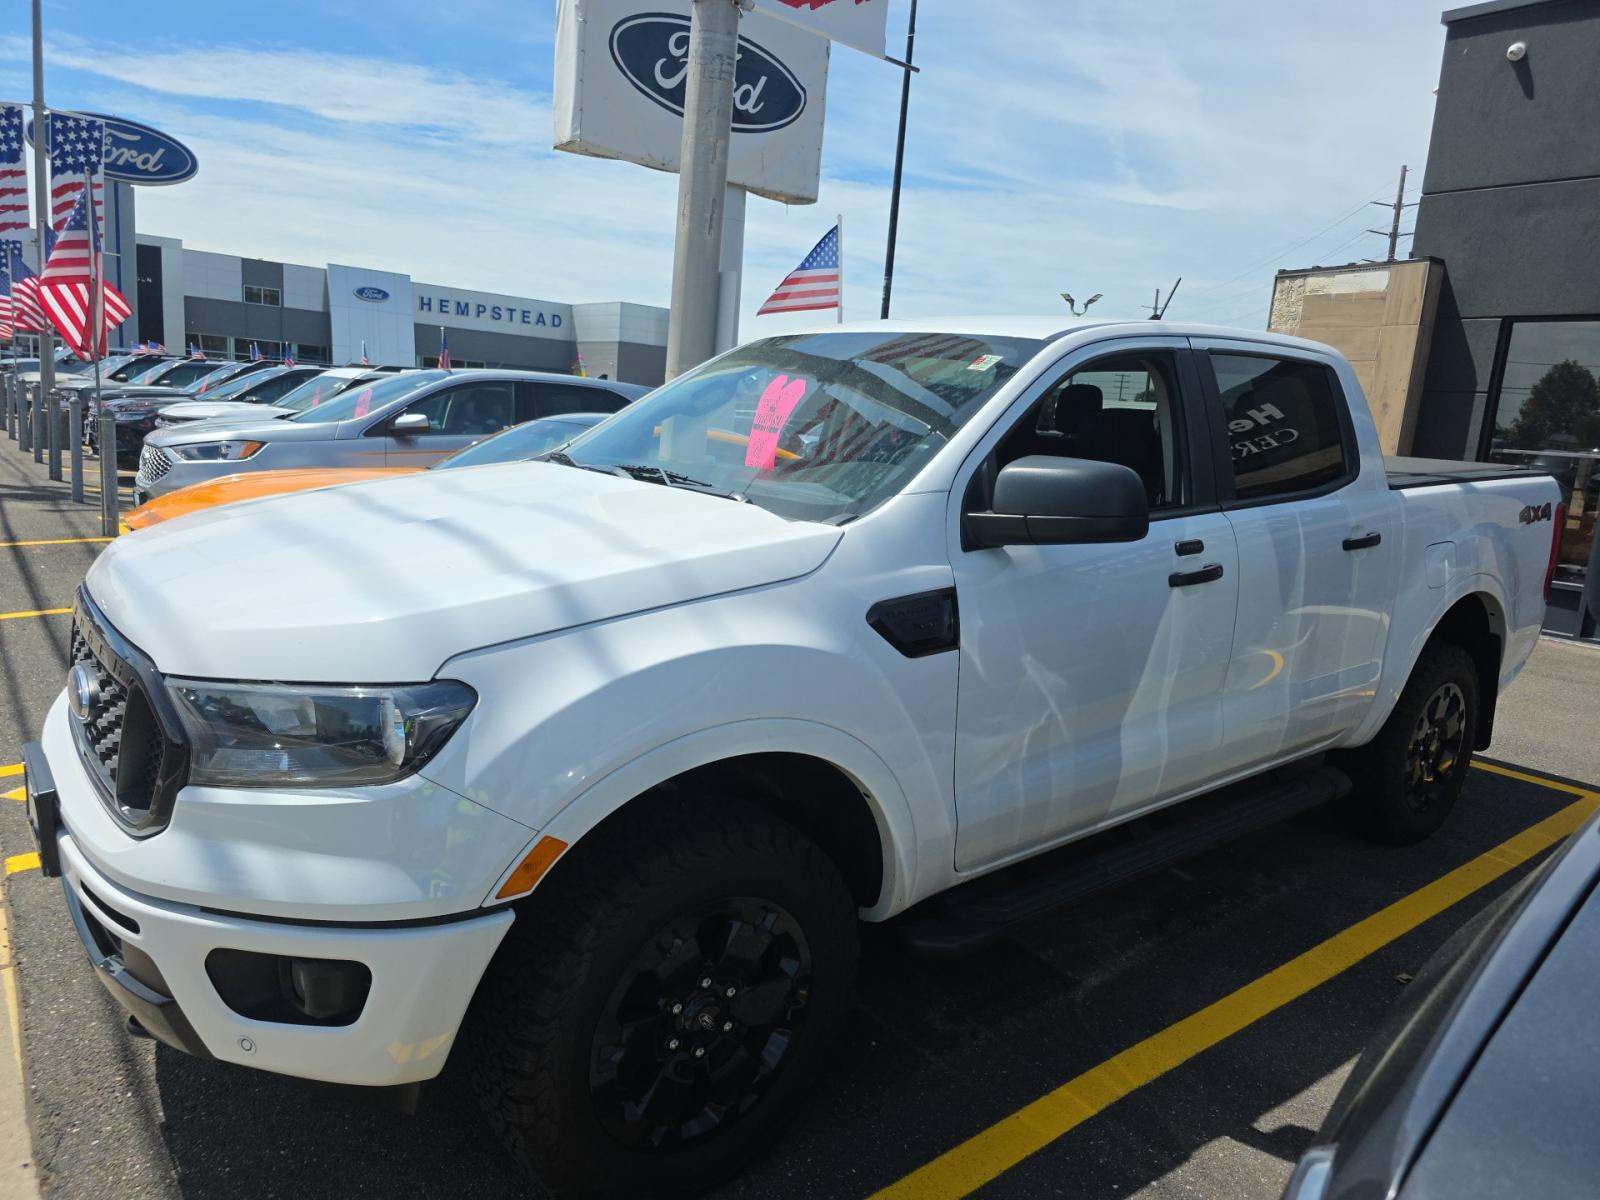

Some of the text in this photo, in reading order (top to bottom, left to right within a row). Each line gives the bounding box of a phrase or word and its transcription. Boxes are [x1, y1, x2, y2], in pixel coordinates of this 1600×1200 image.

[653, 31, 767, 114] Fd
[362, 288, 386, 300] Ford
[419, 296, 563, 328] HEMPSTEAD
